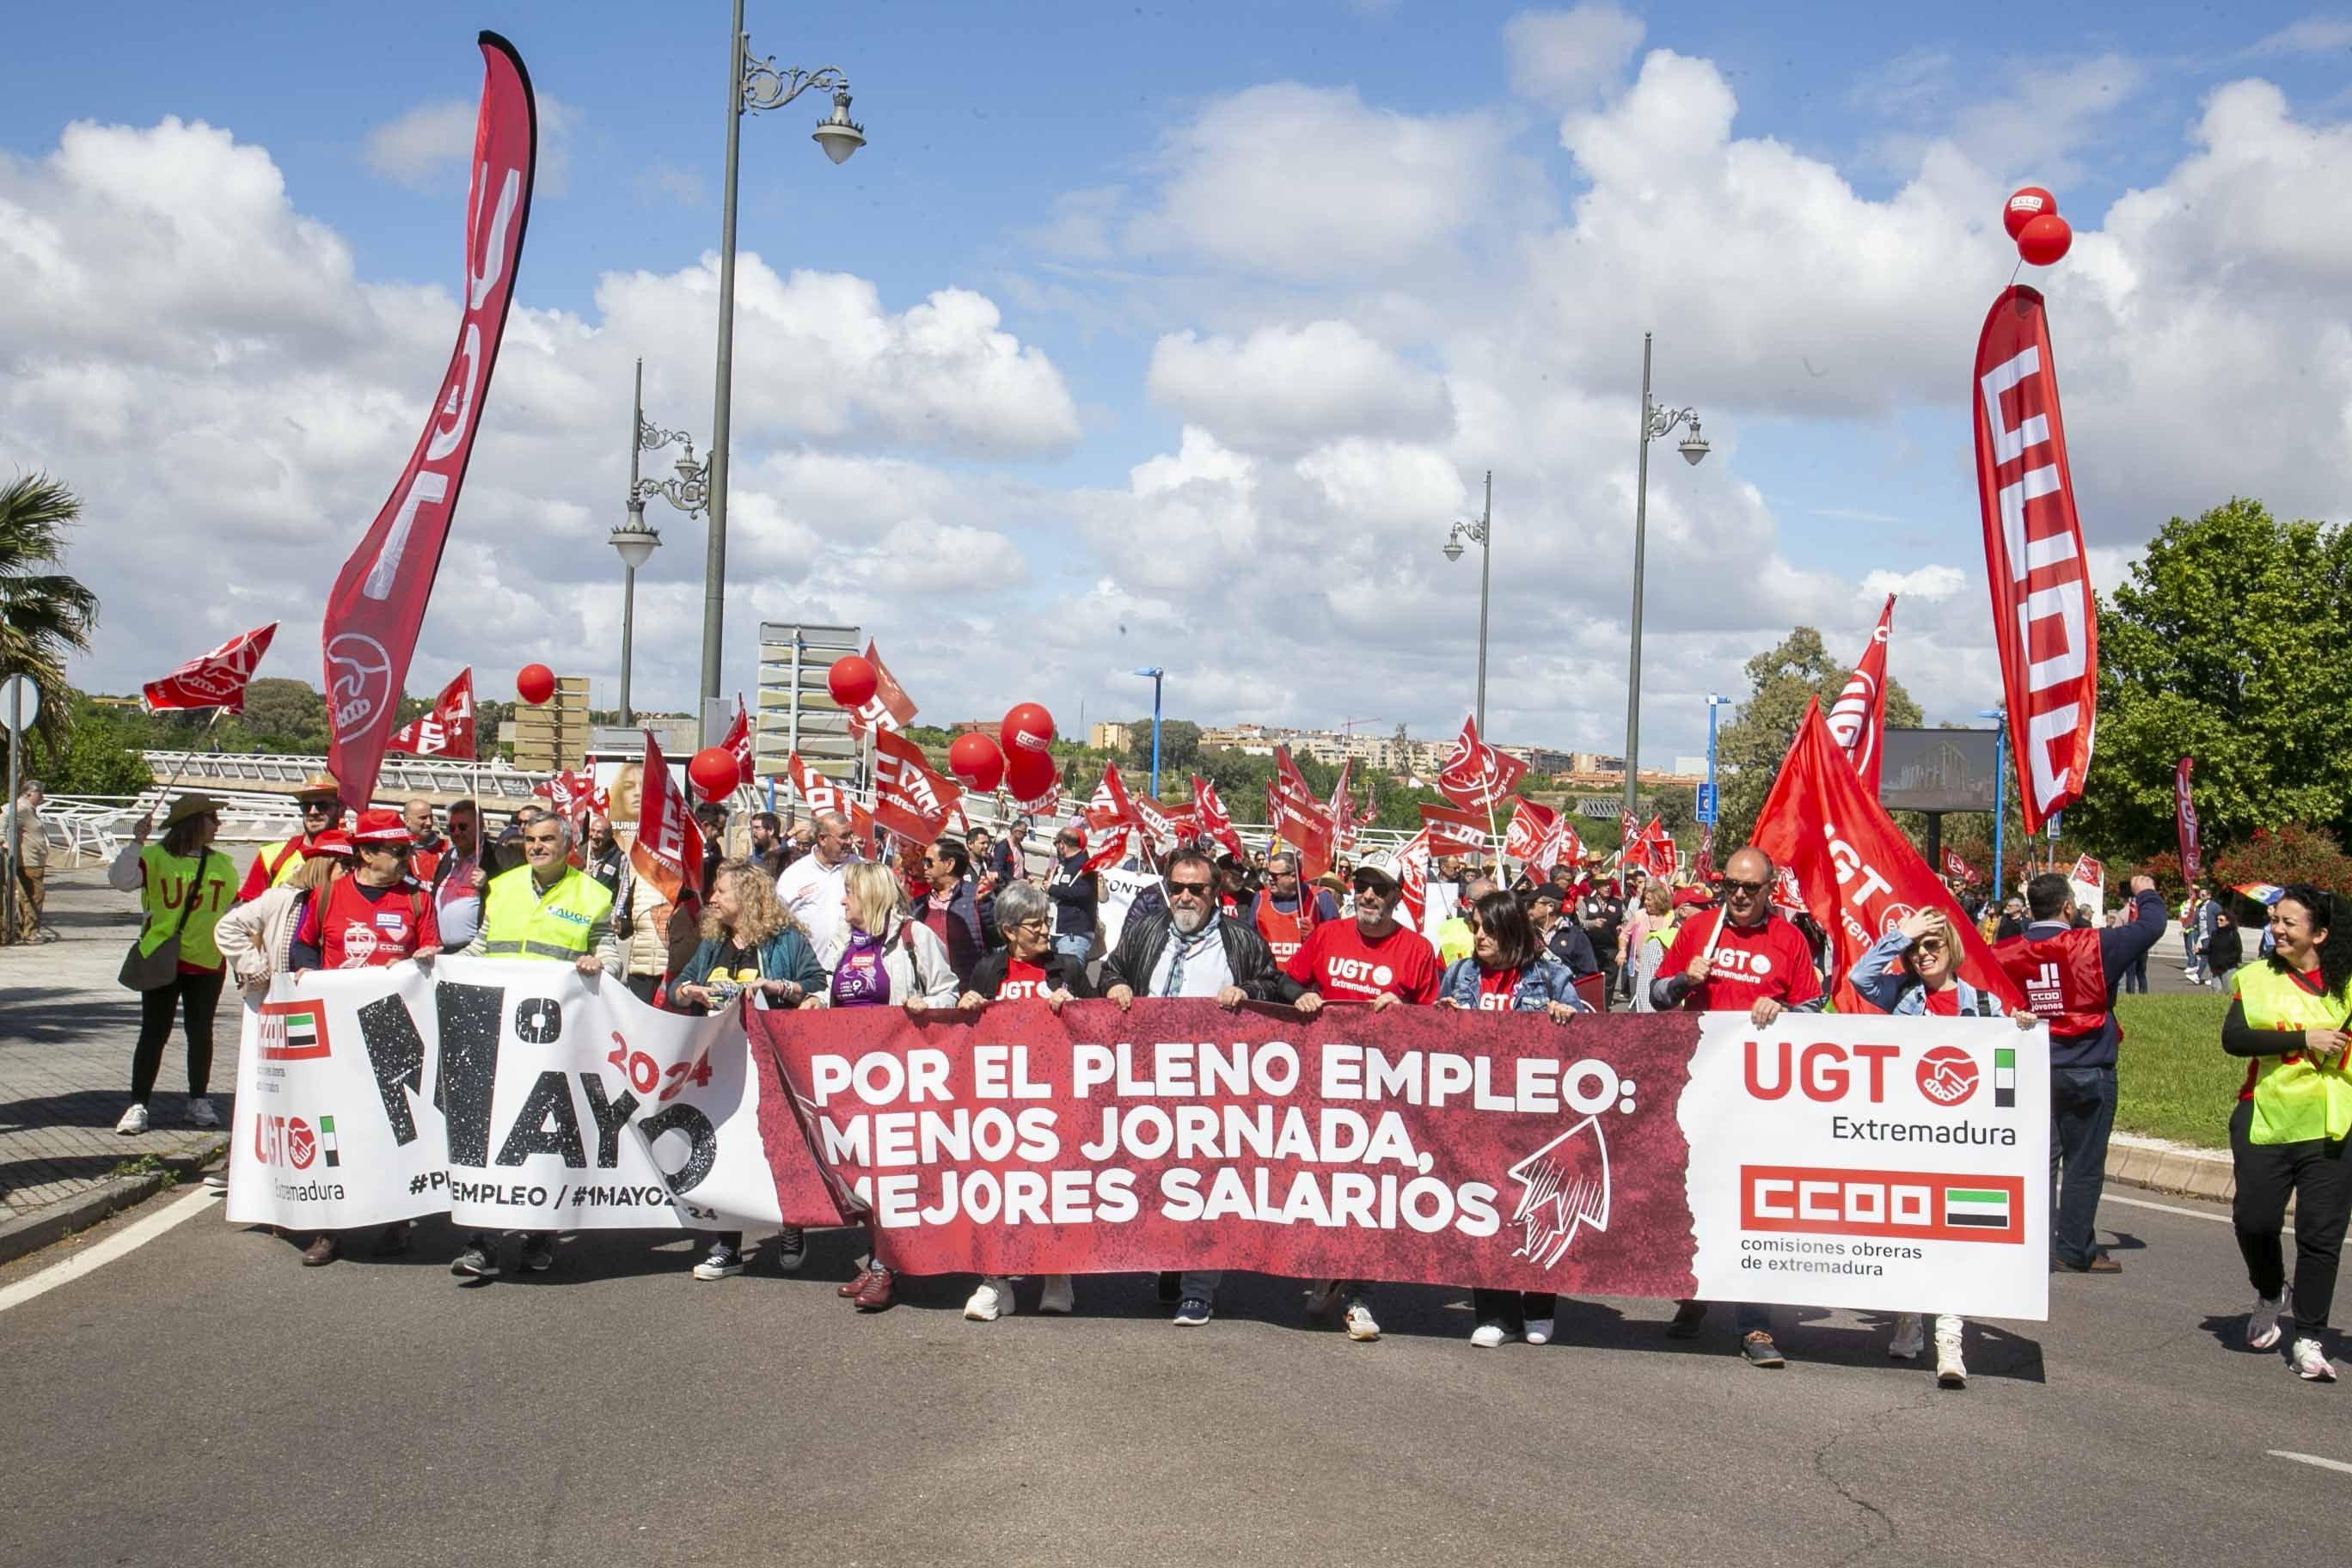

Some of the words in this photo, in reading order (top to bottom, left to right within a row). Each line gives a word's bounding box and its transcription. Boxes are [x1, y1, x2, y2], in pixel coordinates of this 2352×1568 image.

[363, 161, 520, 599] UGT
[1981, 345, 2088, 814] CCOO
[1328, 957, 1373, 981] UGT
[1332, 977, 1381, 995] Extremadura
[2030, 992, 2060, 1001] CCOO
[2031, 1002, 2064, 1012] jóvenes
[608, 1032, 714, 1102] 2024
[811, 1050, 954, 1107] POR
[974, 1045, 1052, 1099] EL
[1073, 1041, 1300, 1099] PLENO
[1320, 1044, 1636, 1114] EMPLEO:
[1744, 1042, 1901, 1103] UGT
[818, 1107, 1060, 1167] MENOS
[1081, 1105, 1434, 1175] JORNADA,
[1832, 1116, 2017, 1146] Extremadura
[1161, 1167, 1501, 1237] SALARIOS
[1754, 1179, 1932, 1226] CCOO
[1740, 1255, 1762, 1270] de
[1767, 1259, 1883, 1277] extremadura
[1741, 1238, 1846, 1256] comisiones
[1852, 1241, 1923, 1259] obreras
